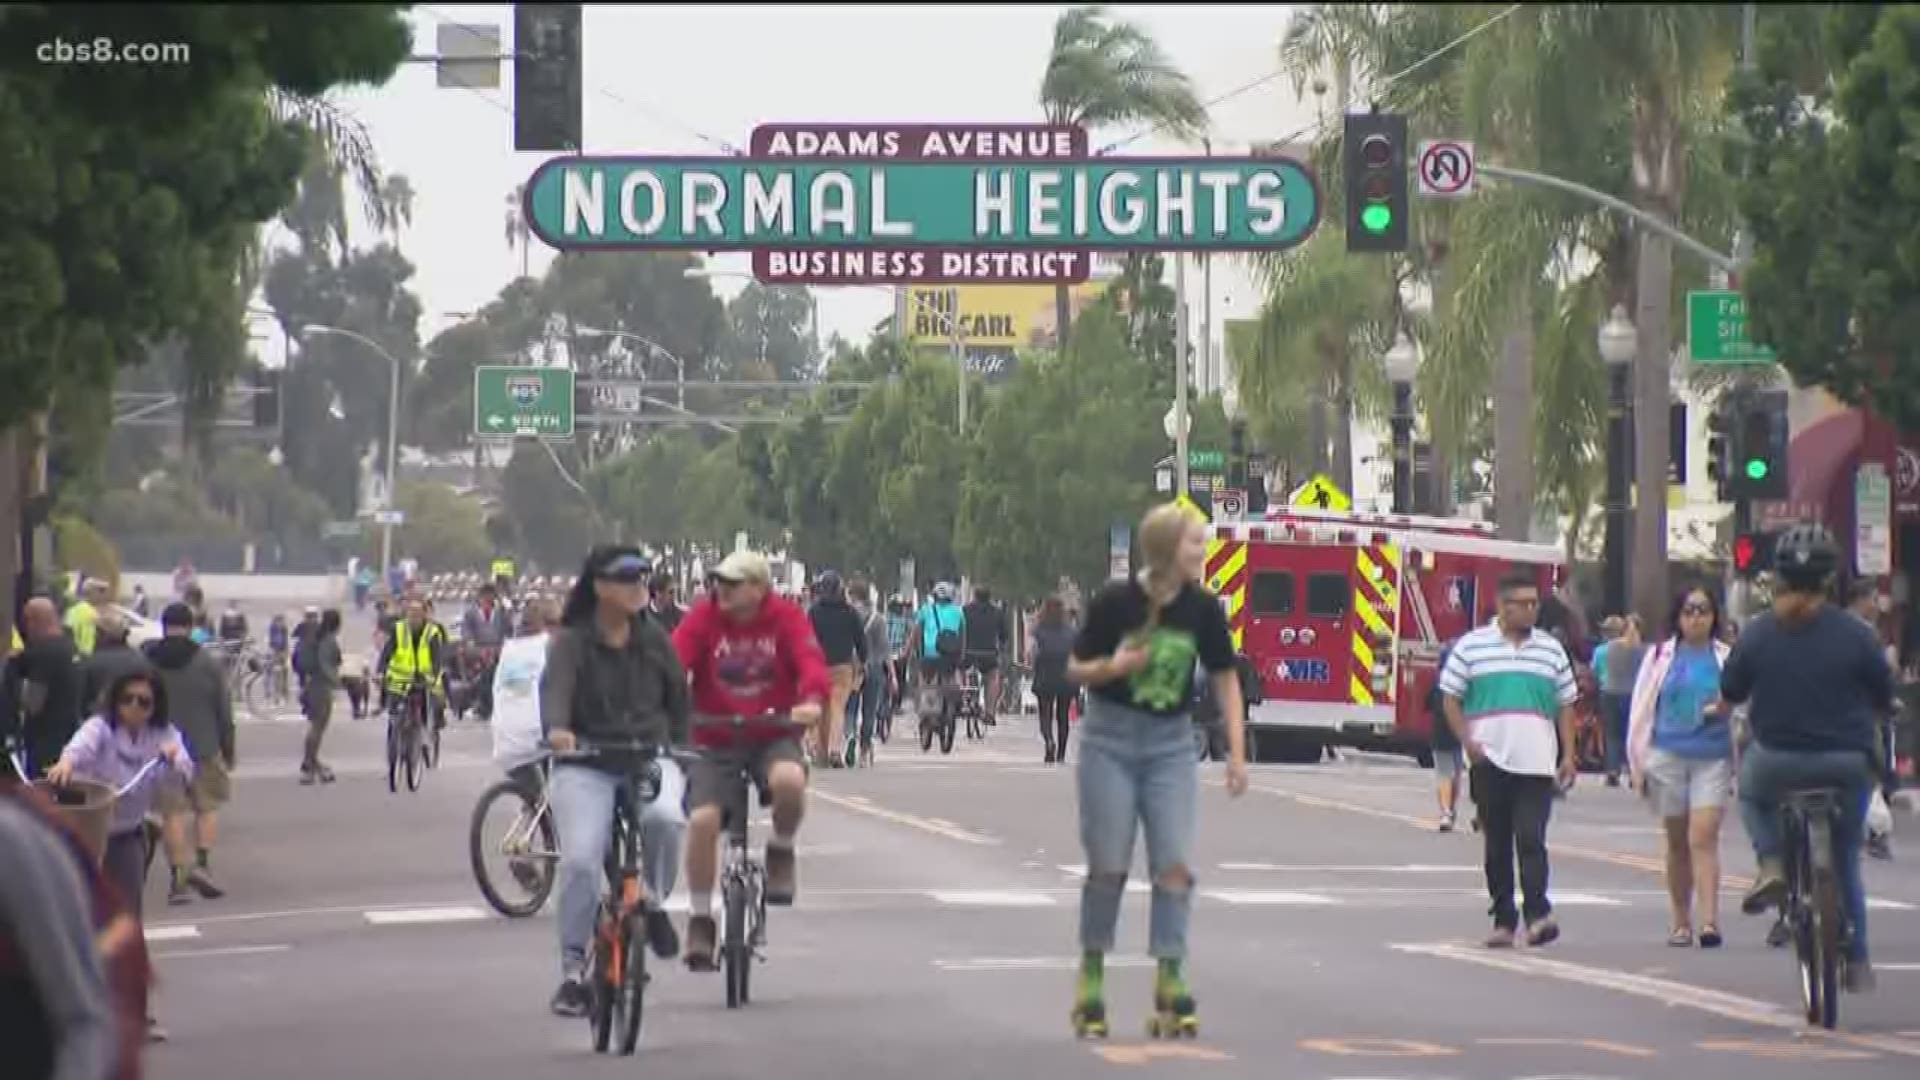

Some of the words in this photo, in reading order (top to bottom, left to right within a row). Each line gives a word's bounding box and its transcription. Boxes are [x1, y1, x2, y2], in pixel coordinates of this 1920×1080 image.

[768, 131, 901, 157] ADAMS
[922, 131, 1072, 157] AVENUE
[561, 168, 913, 237] NORMAL
[973, 168, 1287, 237] HEIGHTS
[768, 251, 925, 277] BUSINESS
[942, 251, 1078, 277] DISTRICT
[1719, 299, 1746, 315] Fel
[959, 313, 1016, 337] CARL
[511, 413, 560, 428] NORTH
